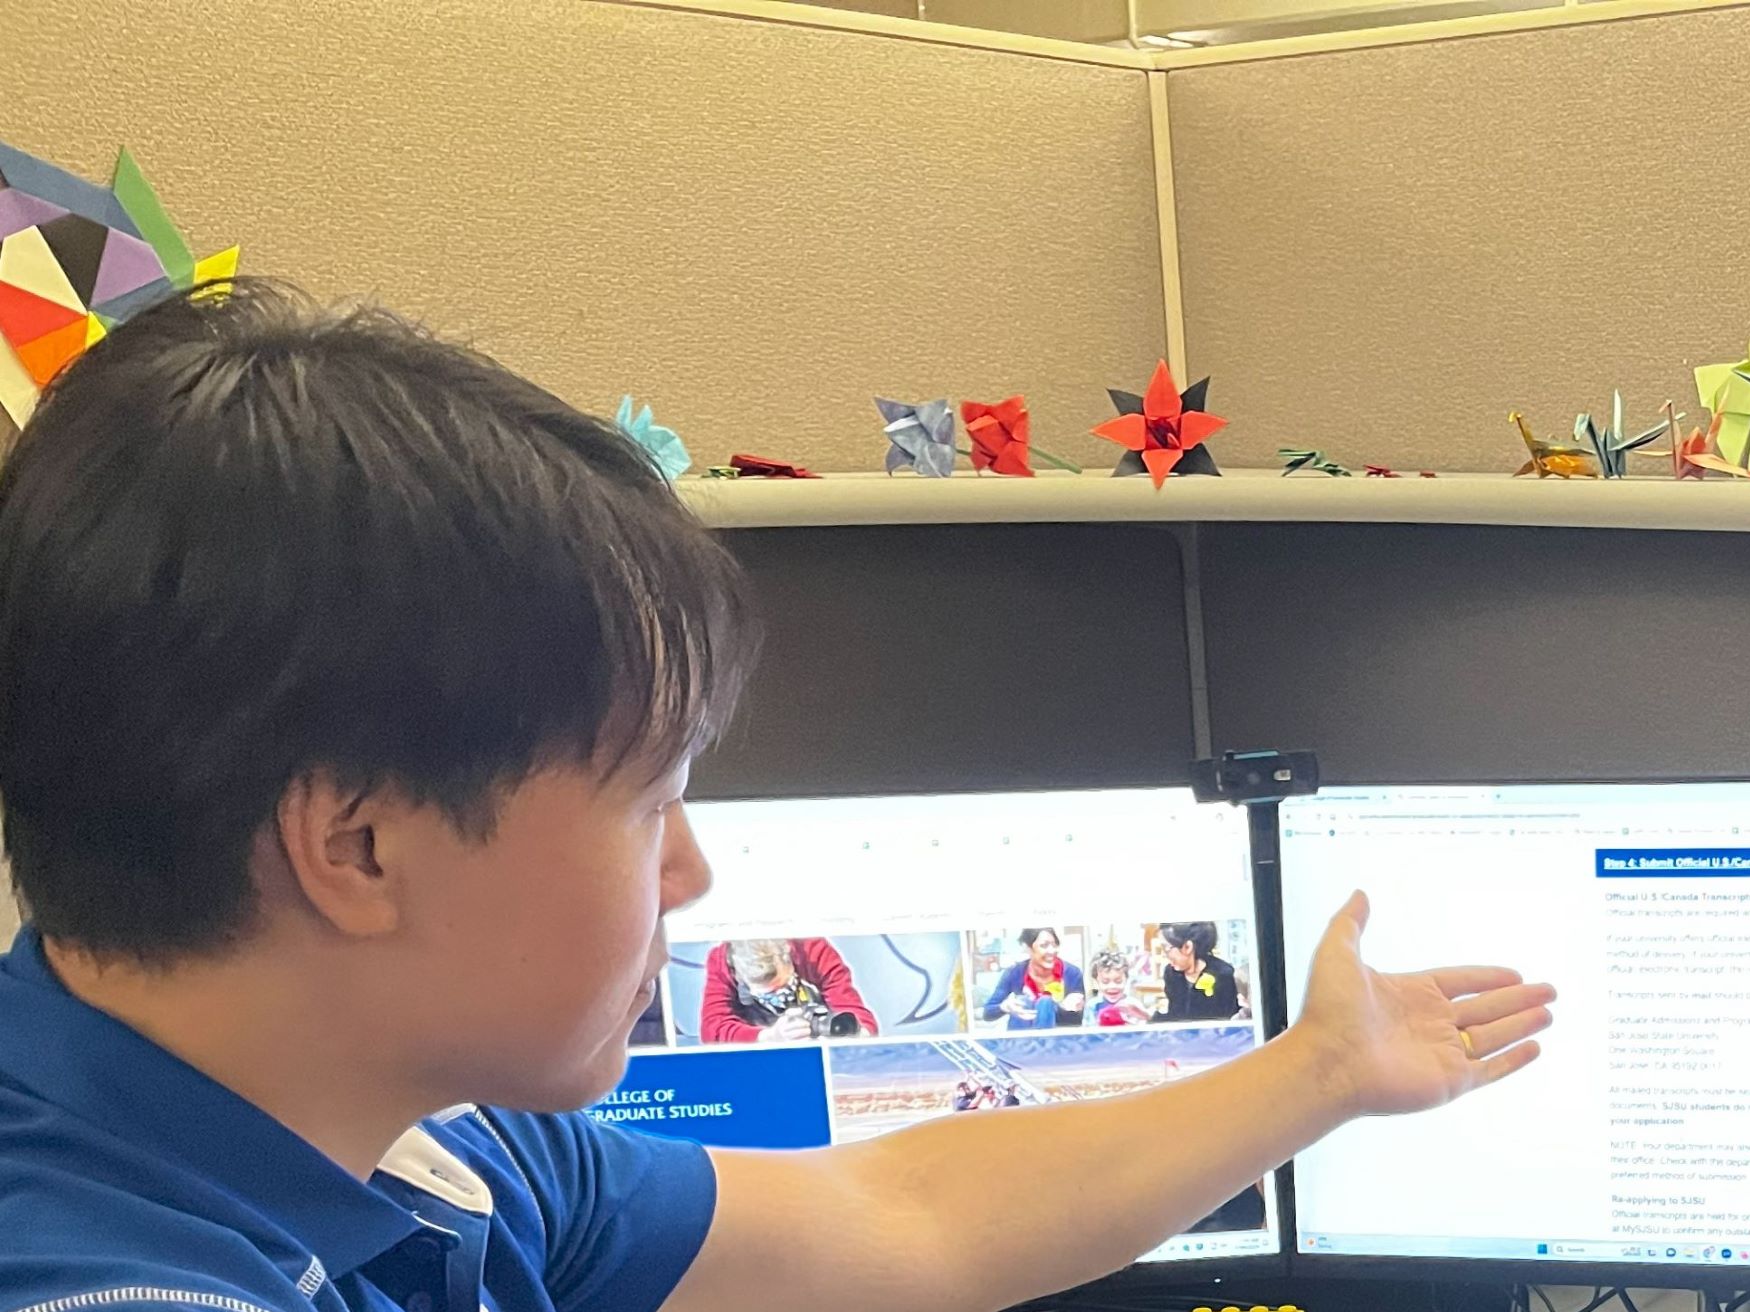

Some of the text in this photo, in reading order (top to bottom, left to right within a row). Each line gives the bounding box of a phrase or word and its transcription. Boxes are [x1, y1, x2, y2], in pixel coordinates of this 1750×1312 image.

[1604, 857, 1626, 868] Step
[1640, 857, 1673, 869] Submit
[1676, 857, 1710, 869] Official
[654, 1089, 675, 1103] OF
[669, 1103, 733, 1118] STUDIES
[1662, 1102, 1686, 1111] SJSU
[1690, 1103, 1730, 1111] students
[1669, 1196, 1678, 1205] to
[1681, 1196, 1706, 1205] SJSU
